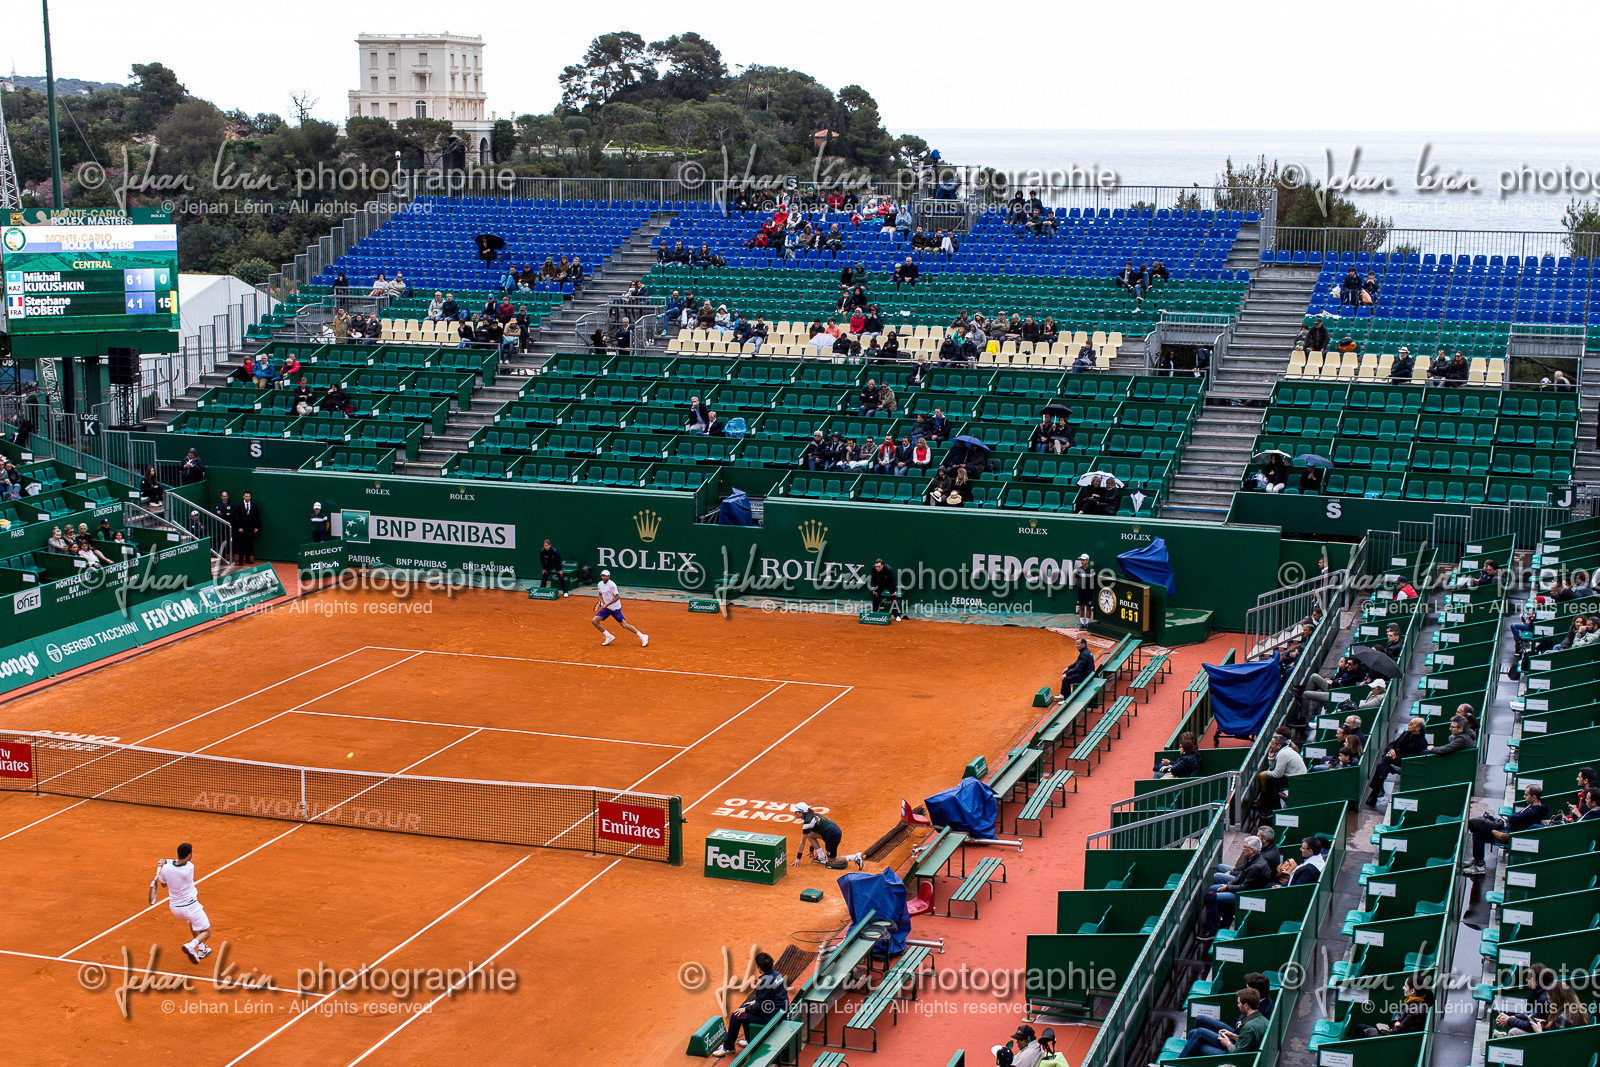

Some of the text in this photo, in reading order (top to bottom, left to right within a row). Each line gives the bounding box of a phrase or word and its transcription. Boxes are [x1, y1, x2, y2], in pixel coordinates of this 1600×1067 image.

[50, 209, 126, 218] MONTE-CARLO
[51, 217, 133, 225] ROLEX MASTERS
[46, 234, 112, 243] MONTE-CARLO
[62, 240, 134, 250] ROLEX MASTERS
[73, 260, 112, 269] CENTRAL
[24, 272, 61, 282] Mikhail
[126, 274, 167, 285] 6 1 0
[25, 281, 84, 292] KUKUSHKIN
[25, 296, 71, 306] Stephane
[128, 297, 171, 309] 4 1 15
[26, 306, 65, 316] ROBERT
[84, 422, 96, 435] K
[250, 443, 262, 457] S
[1558, 490, 1571, 507] J
[1326, 502, 1341, 518] S
[11, 529, 24, 538] PARIS
[376, 519, 506, 545] BNP PARIBAS
[1121, 533, 1150, 541] ROLEX
[160, 543, 199, 560] SERGIO TACCHINI
[304, 546, 342, 556] PEUGEOT
[348, 554, 380, 563] PARIBAS
[396, 558, 447, 568] BNP PARIBAS
[597, 547, 698, 573] ROLEX
[463, 562, 514, 573] BNP PARIBAS
[760, 557, 866, 584] ROLEX
[952, 597, 982, 606] FEDCOM
[1120, 600, 1138, 609] ROLEX
[141, 598, 199, 631] FEDCOM
[1121, 608, 1138, 622] 0:51
[61, 622, 139, 656] SERGIO TACCHINI
[0, 651, 39, 678] ongo
[192, 792, 240, 810] ATP
[353, 807, 422, 830] TOUR
[622, 811, 639, 824] Fly
[602, 818, 660, 839] Emirates
[707, 846, 771, 873] FedEx
